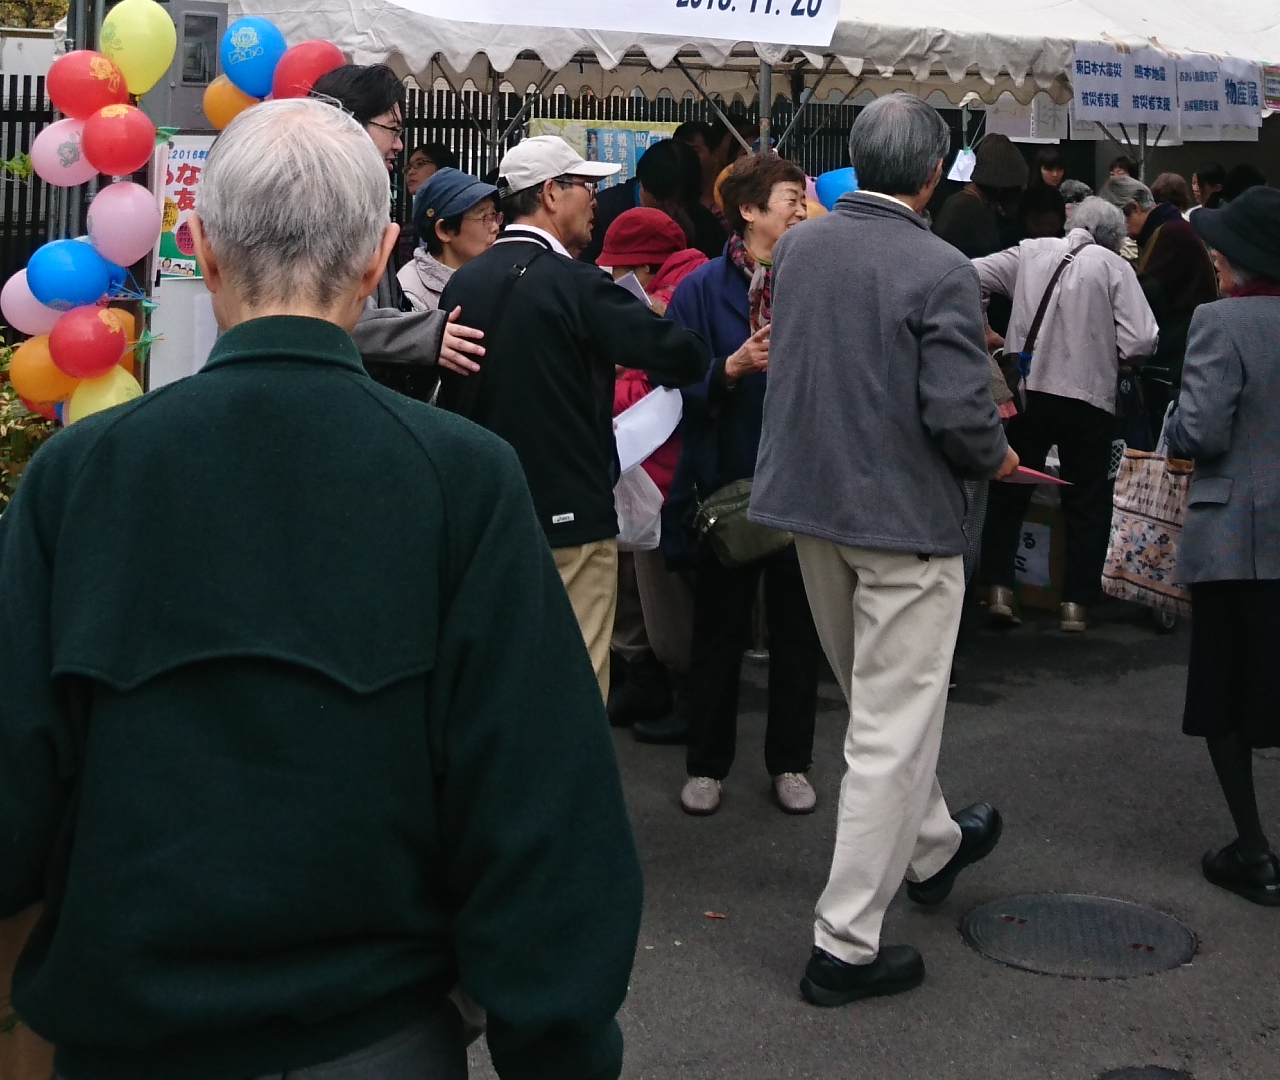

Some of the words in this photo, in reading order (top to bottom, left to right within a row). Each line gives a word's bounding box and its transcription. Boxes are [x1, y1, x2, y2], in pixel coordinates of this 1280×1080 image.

[1076, 59, 1122, 78] 東日本大震災
[1134, 65, 1166, 81] 熊本地震
[1081, 91, 1120, 108] 被災者支援
[1225, 78, 1259, 107] 物産展
[1132, 93, 1171, 111] 被災者支援
[168, 149, 209, 160] 2016年
